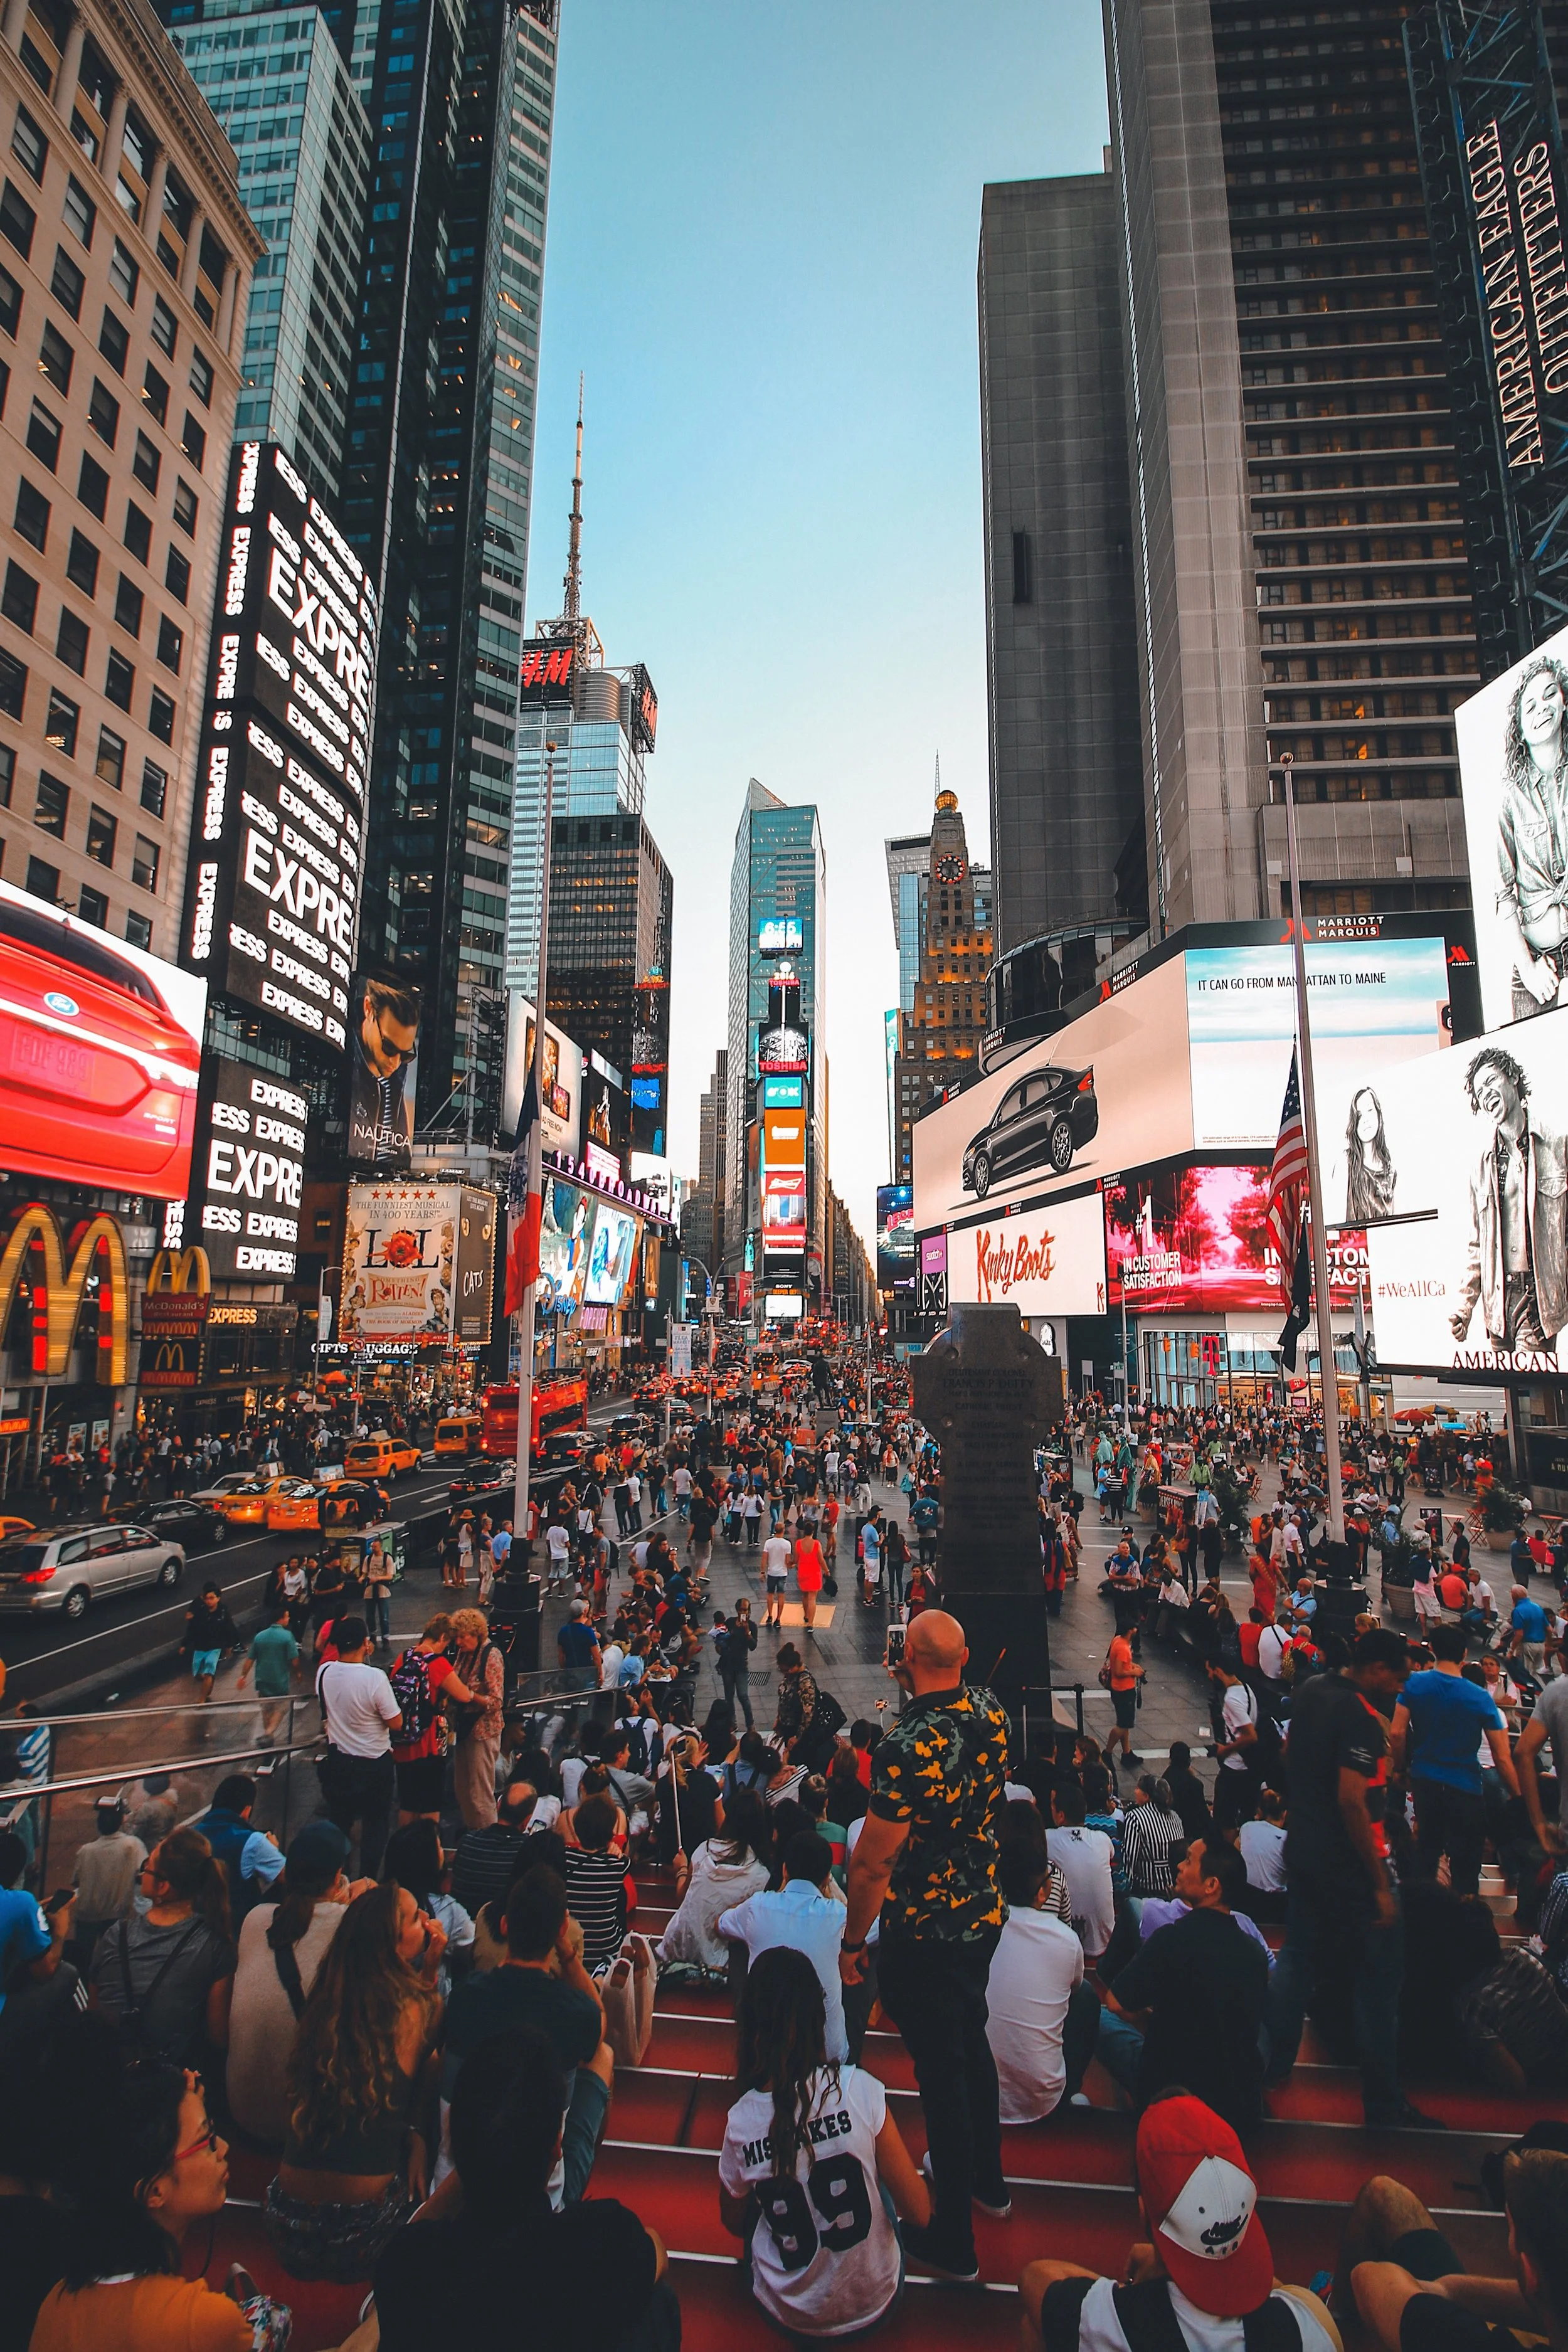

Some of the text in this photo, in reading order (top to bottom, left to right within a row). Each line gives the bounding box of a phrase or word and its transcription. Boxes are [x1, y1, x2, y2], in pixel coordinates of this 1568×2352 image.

[1514, 142, 1568, 395] OUTFITTERS
[1466, 119, 1544, 469] AMERICAN EAGLE
[309, 497, 363, 582] EXPRESS
[225, 526, 252, 617] EXPRESS
[303, 521, 359, 605] EXPRESS
[304, 556, 359, 638] EXPRESS
[292, 635, 349, 711] EXPRESS
[521, 649, 573, 688] H&M
[294, 671, 349, 745] EXPRESS
[287, 701, 344, 773] EXPRESS
[202, 746, 229, 841] EXPRESS
[287, 756, 345, 824] EXPRESS
[278, 784, 337, 850] EXPRESS
[282, 824, 340, 884] EXPRESS
[190, 861, 218, 961] EXPRESS
[765, 922, 797, 935] 6:55
[1318, 916, 1384, 927] MARRIOTT
[1318, 927, 1377, 938] MARQUIS
[267, 908, 329, 965] EXPRESS
[271, 947, 331, 1000] EXPRESS
[1113, 961, 1139, 983] MARRIOTT
[1113, 972, 1136, 992] MARQUIS
[1199, 972, 1387, 991] IT CAN GO FROM MANATTAN TO MAINE
[261, 981, 324, 1031] EXPRESS
[760, 1061, 807, 1071] TOSHIBA
[251, 1078, 305, 1122] EXPRESS
[255, 1115, 305, 1155] EXPRESS
[353, 1123, 411, 1148] NAUTICA
[1103, 1173, 1120, 1183] MARRIOTT
[246, 1212, 298, 1244] EXPRESS
[370, 1210, 380, 1219] IN
[383, 1210, 401, 1219] 400
[1135, 1195, 1153, 1248] #1
[378, 1274, 420, 1283] SOMETHING
[464, 1269, 484, 1297] CATS
[976, 1229, 1056, 1304] Kinky Boots
[1123, 1251, 1181, 1273] IN CUSTOMER
[1123, 1269, 1182, 1290] SATISFACTION
[144, 1301, 205, 1311] McDonald's
[580, 1307, 608, 1330] FOREVER
[1453, 1350, 1559, 1371] AMERICAN
[755, 2152, 871, 2270] 99
